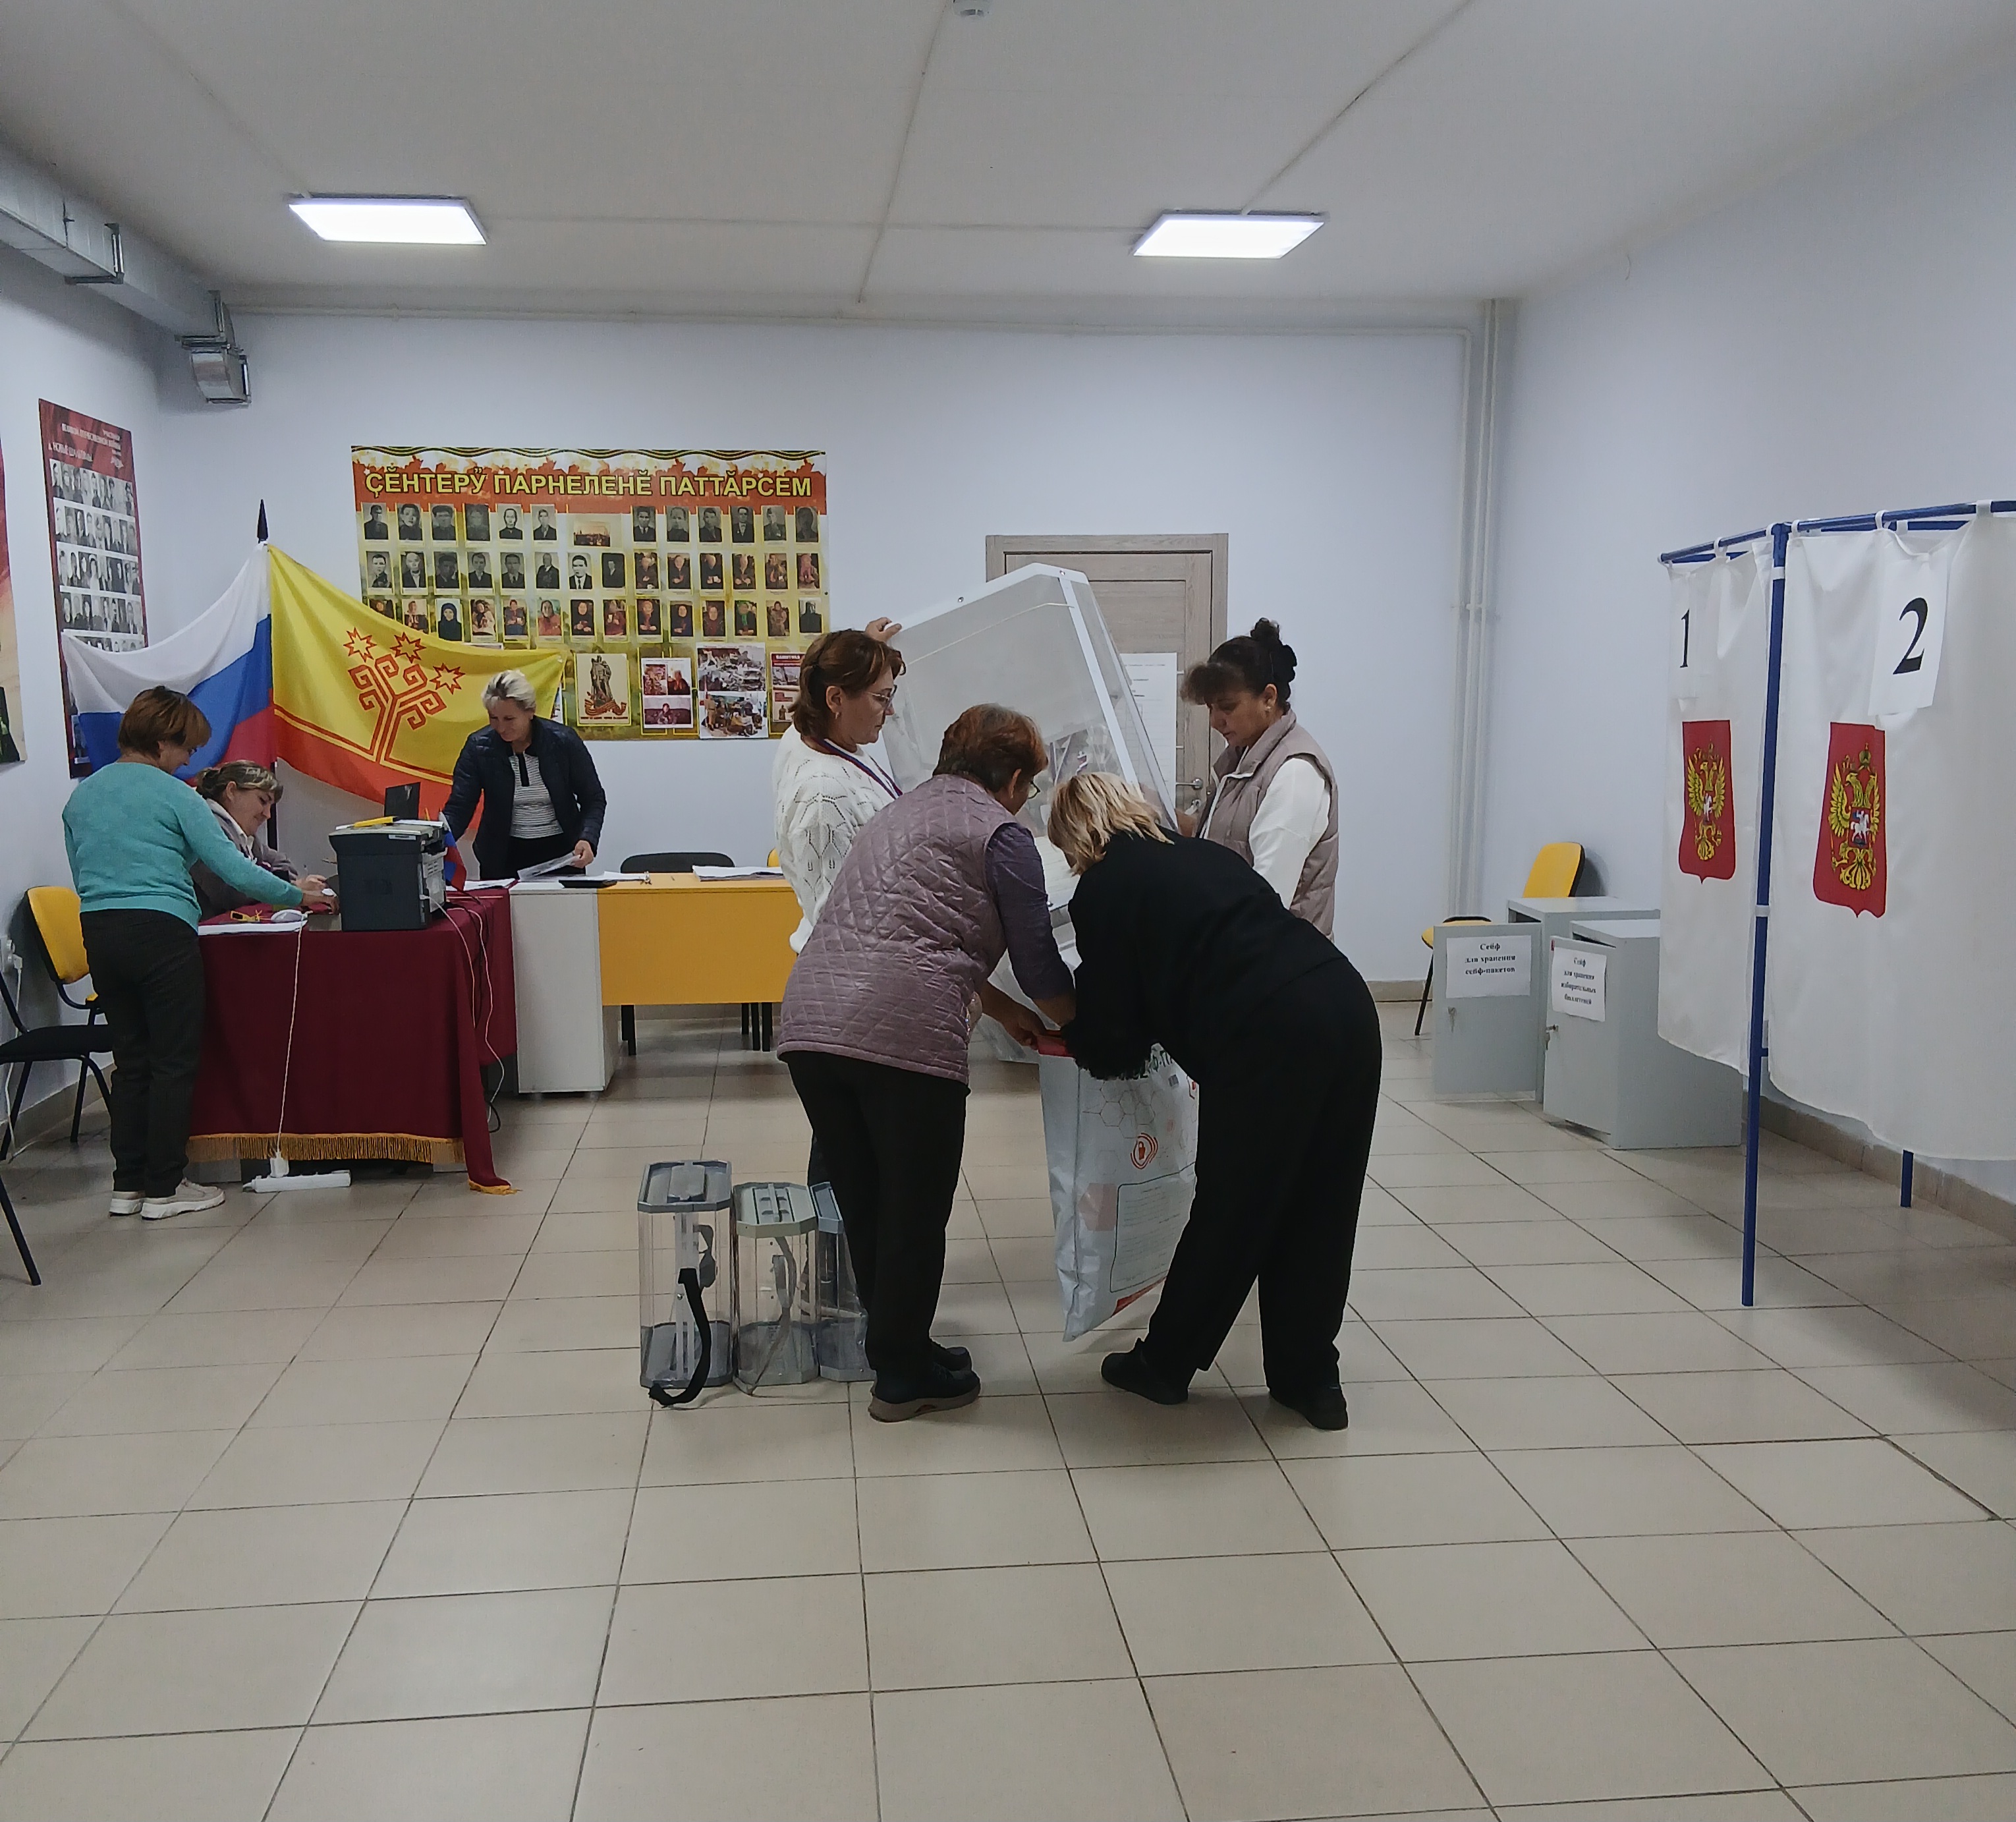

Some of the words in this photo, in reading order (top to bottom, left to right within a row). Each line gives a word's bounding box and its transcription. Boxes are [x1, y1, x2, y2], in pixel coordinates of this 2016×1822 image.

[493, 469, 653, 496] ПАРНЕЛЕНӖ
[659, 470, 812, 497] ПАТТӐРСЕМ
[1679, 608, 1691, 668] 1
[1892, 597, 1928, 675] 2
[1480, 942, 1501, 951] Сейф
